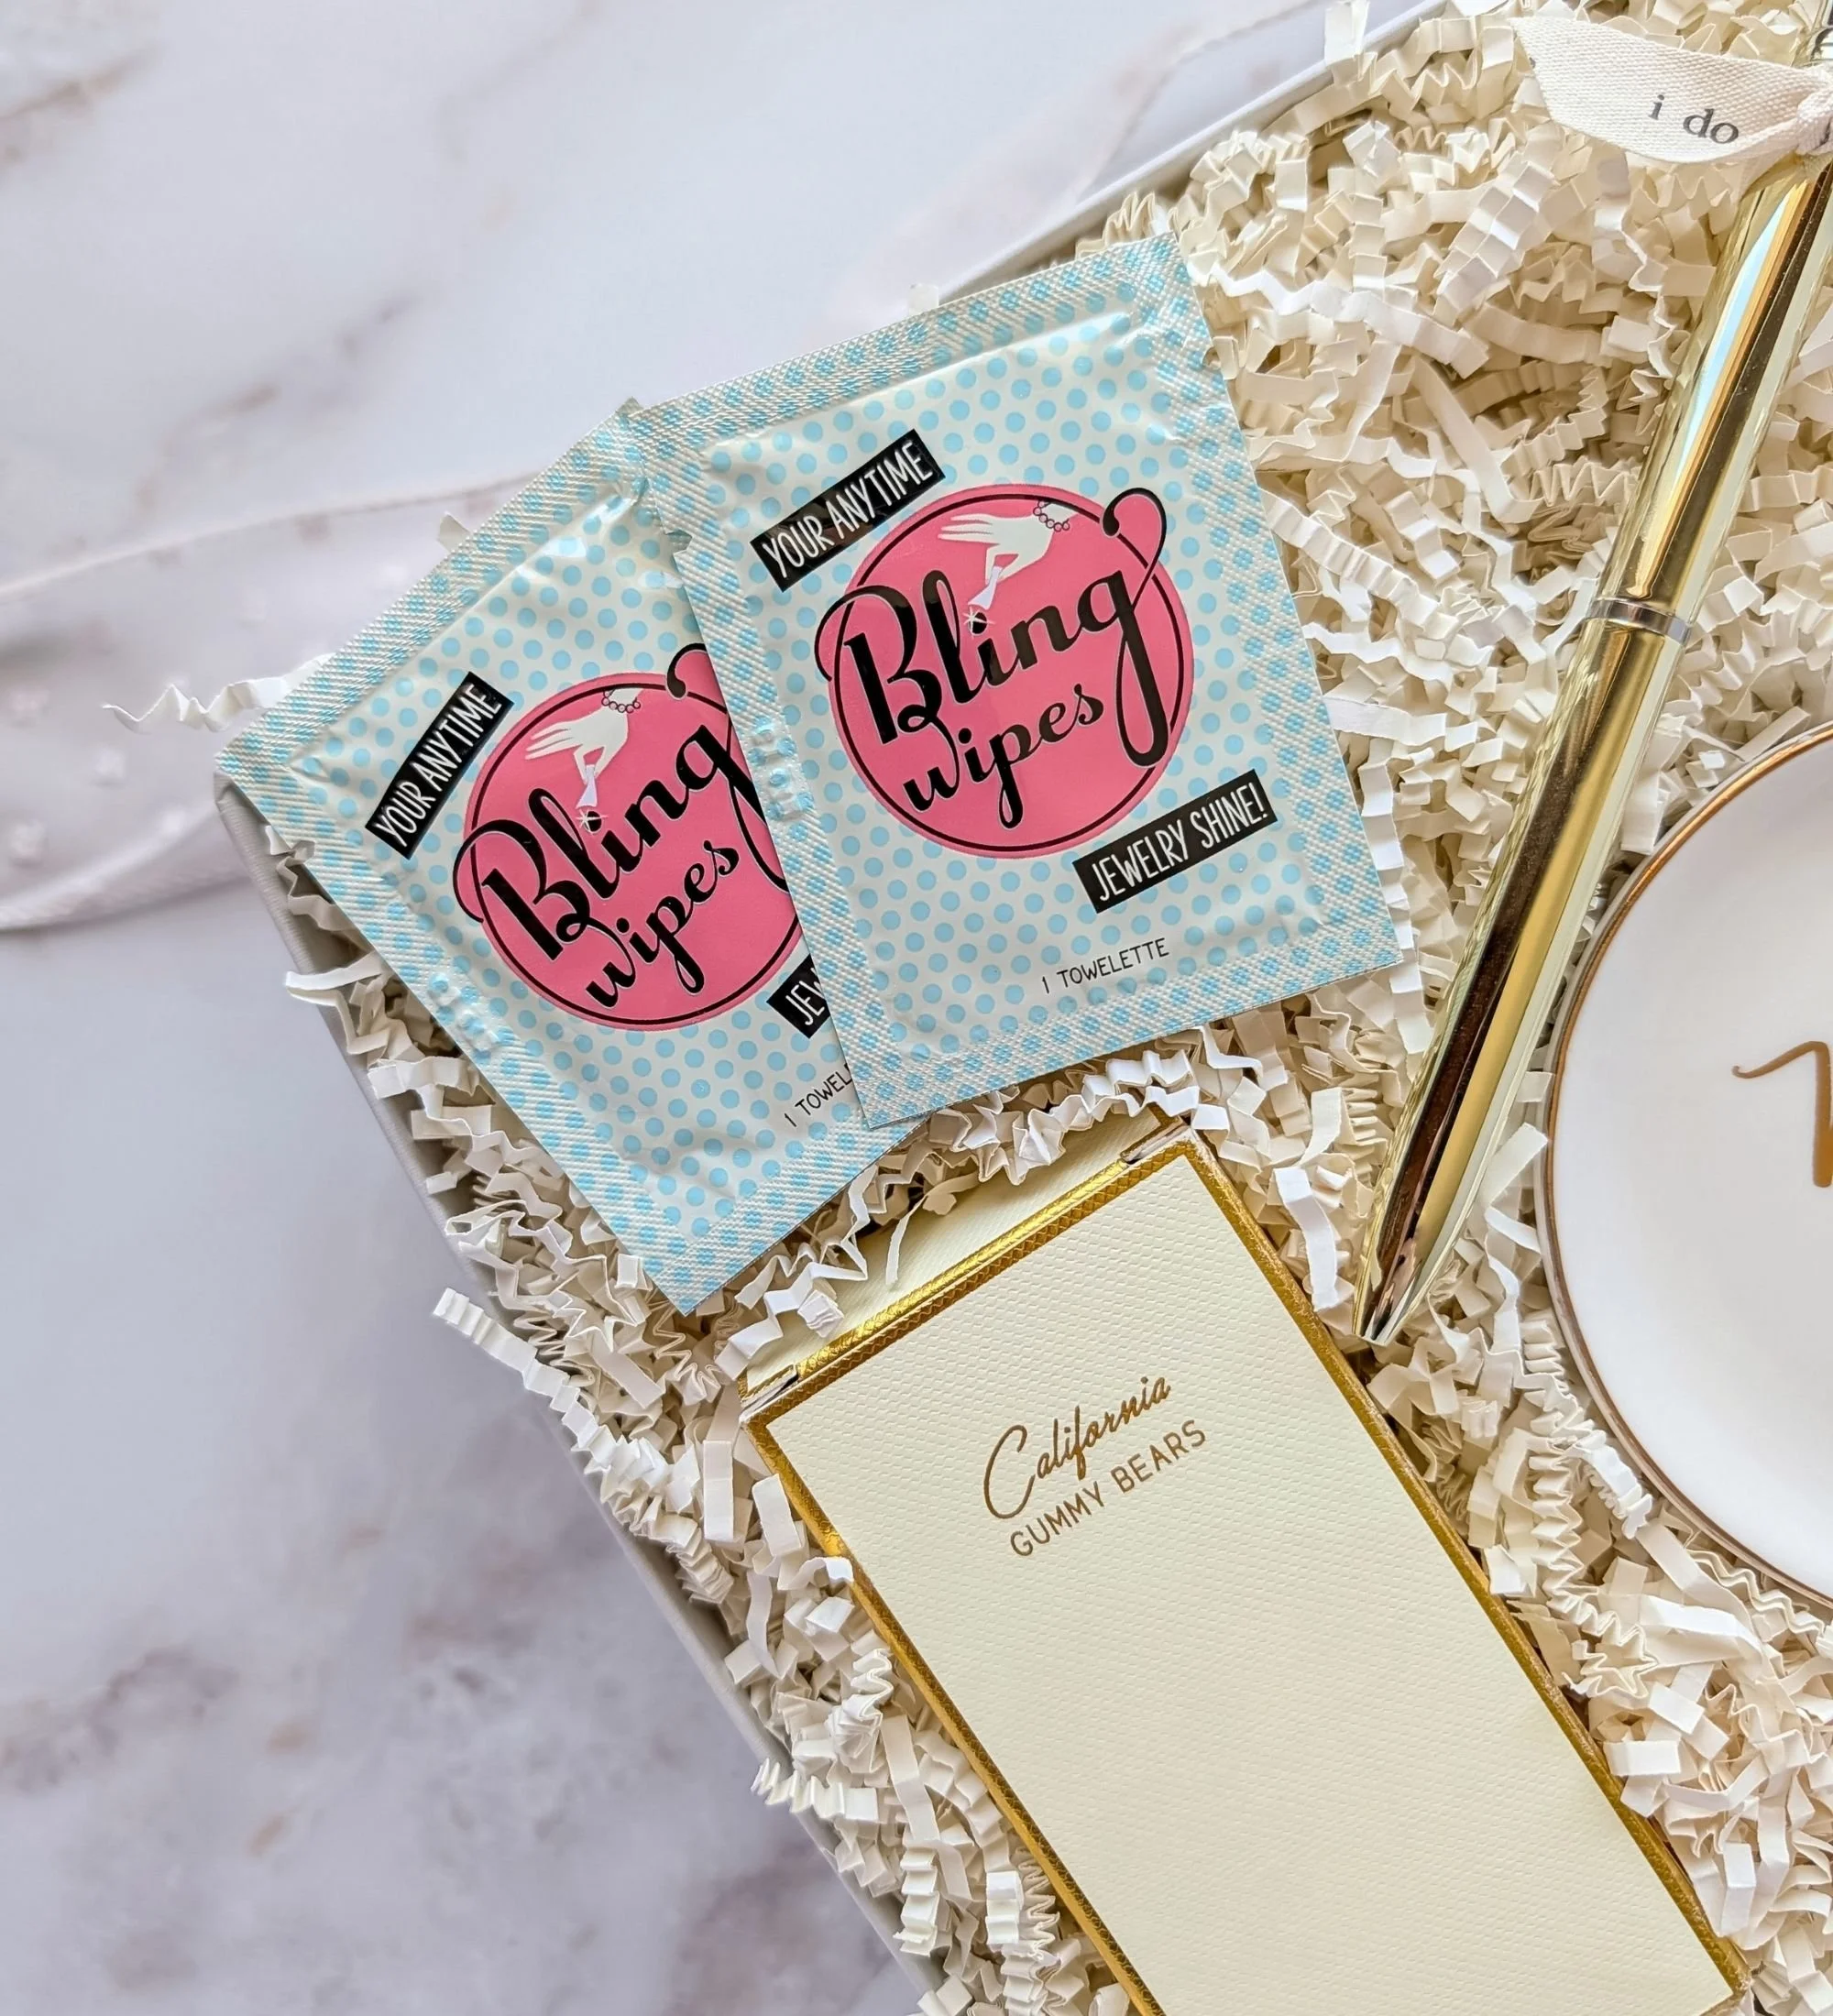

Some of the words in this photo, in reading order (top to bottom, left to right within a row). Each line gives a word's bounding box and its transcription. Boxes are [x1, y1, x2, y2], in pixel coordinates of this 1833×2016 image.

[1649, 94, 1664, 120] i
[1683, 108, 1739, 144] do
[762, 515, 835, 578] YOUR
[825, 441, 933, 540] ANYTIME
[814, 488, 1169, 767] Bling
[374, 781, 436, 848] YOUR
[411, 684, 502, 792] ANYTIME
[903, 683, 1104, 829] wipes
[1092, 819, 1189, 902] JEWELRY
[1191, 782, 1269, 849] SHINE!
[585, 840, 741, 1008] wipes
[1056, 937, 1170, 988] TOWELETTE
[794, 1063, 853, 1116] TOWEL
[983, 1376, 1171, 1519] California
[1010, 1481, 1105, 1557] GUMMY
[1110, 1419, 1206, 1494] BEARS
